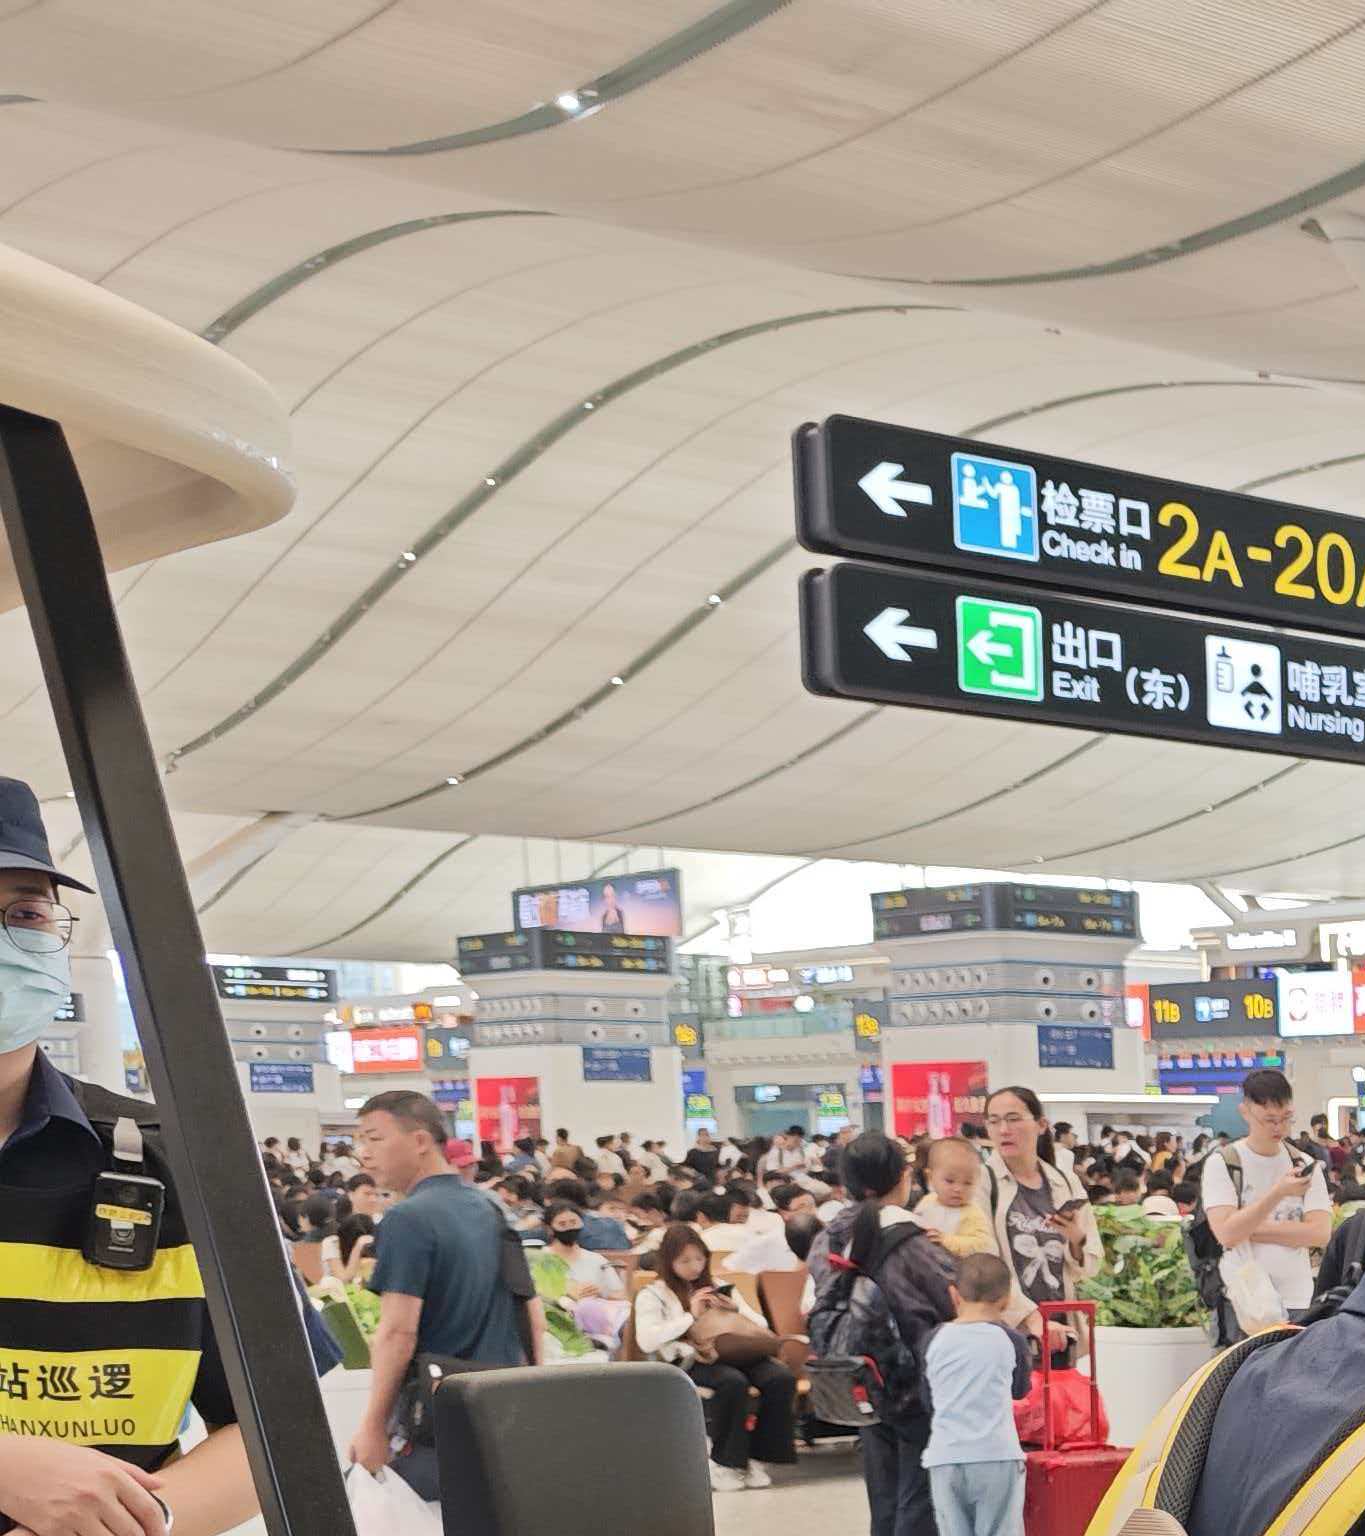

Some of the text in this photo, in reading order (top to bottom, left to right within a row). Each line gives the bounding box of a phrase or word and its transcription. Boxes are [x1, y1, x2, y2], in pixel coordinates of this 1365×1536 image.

[1041, 479, 1151, 541] 检票口
[1042, 533, 1142, 572] Check in
[1051, 621, 1122, 672] 出口
[1052, 674, 1101, 703] Exit
[1287, 706, 1365, 744] Nursing
[1243, 992, 1275, 1020] 10B
[0, 1362, 136, 1401] 站巡逻
